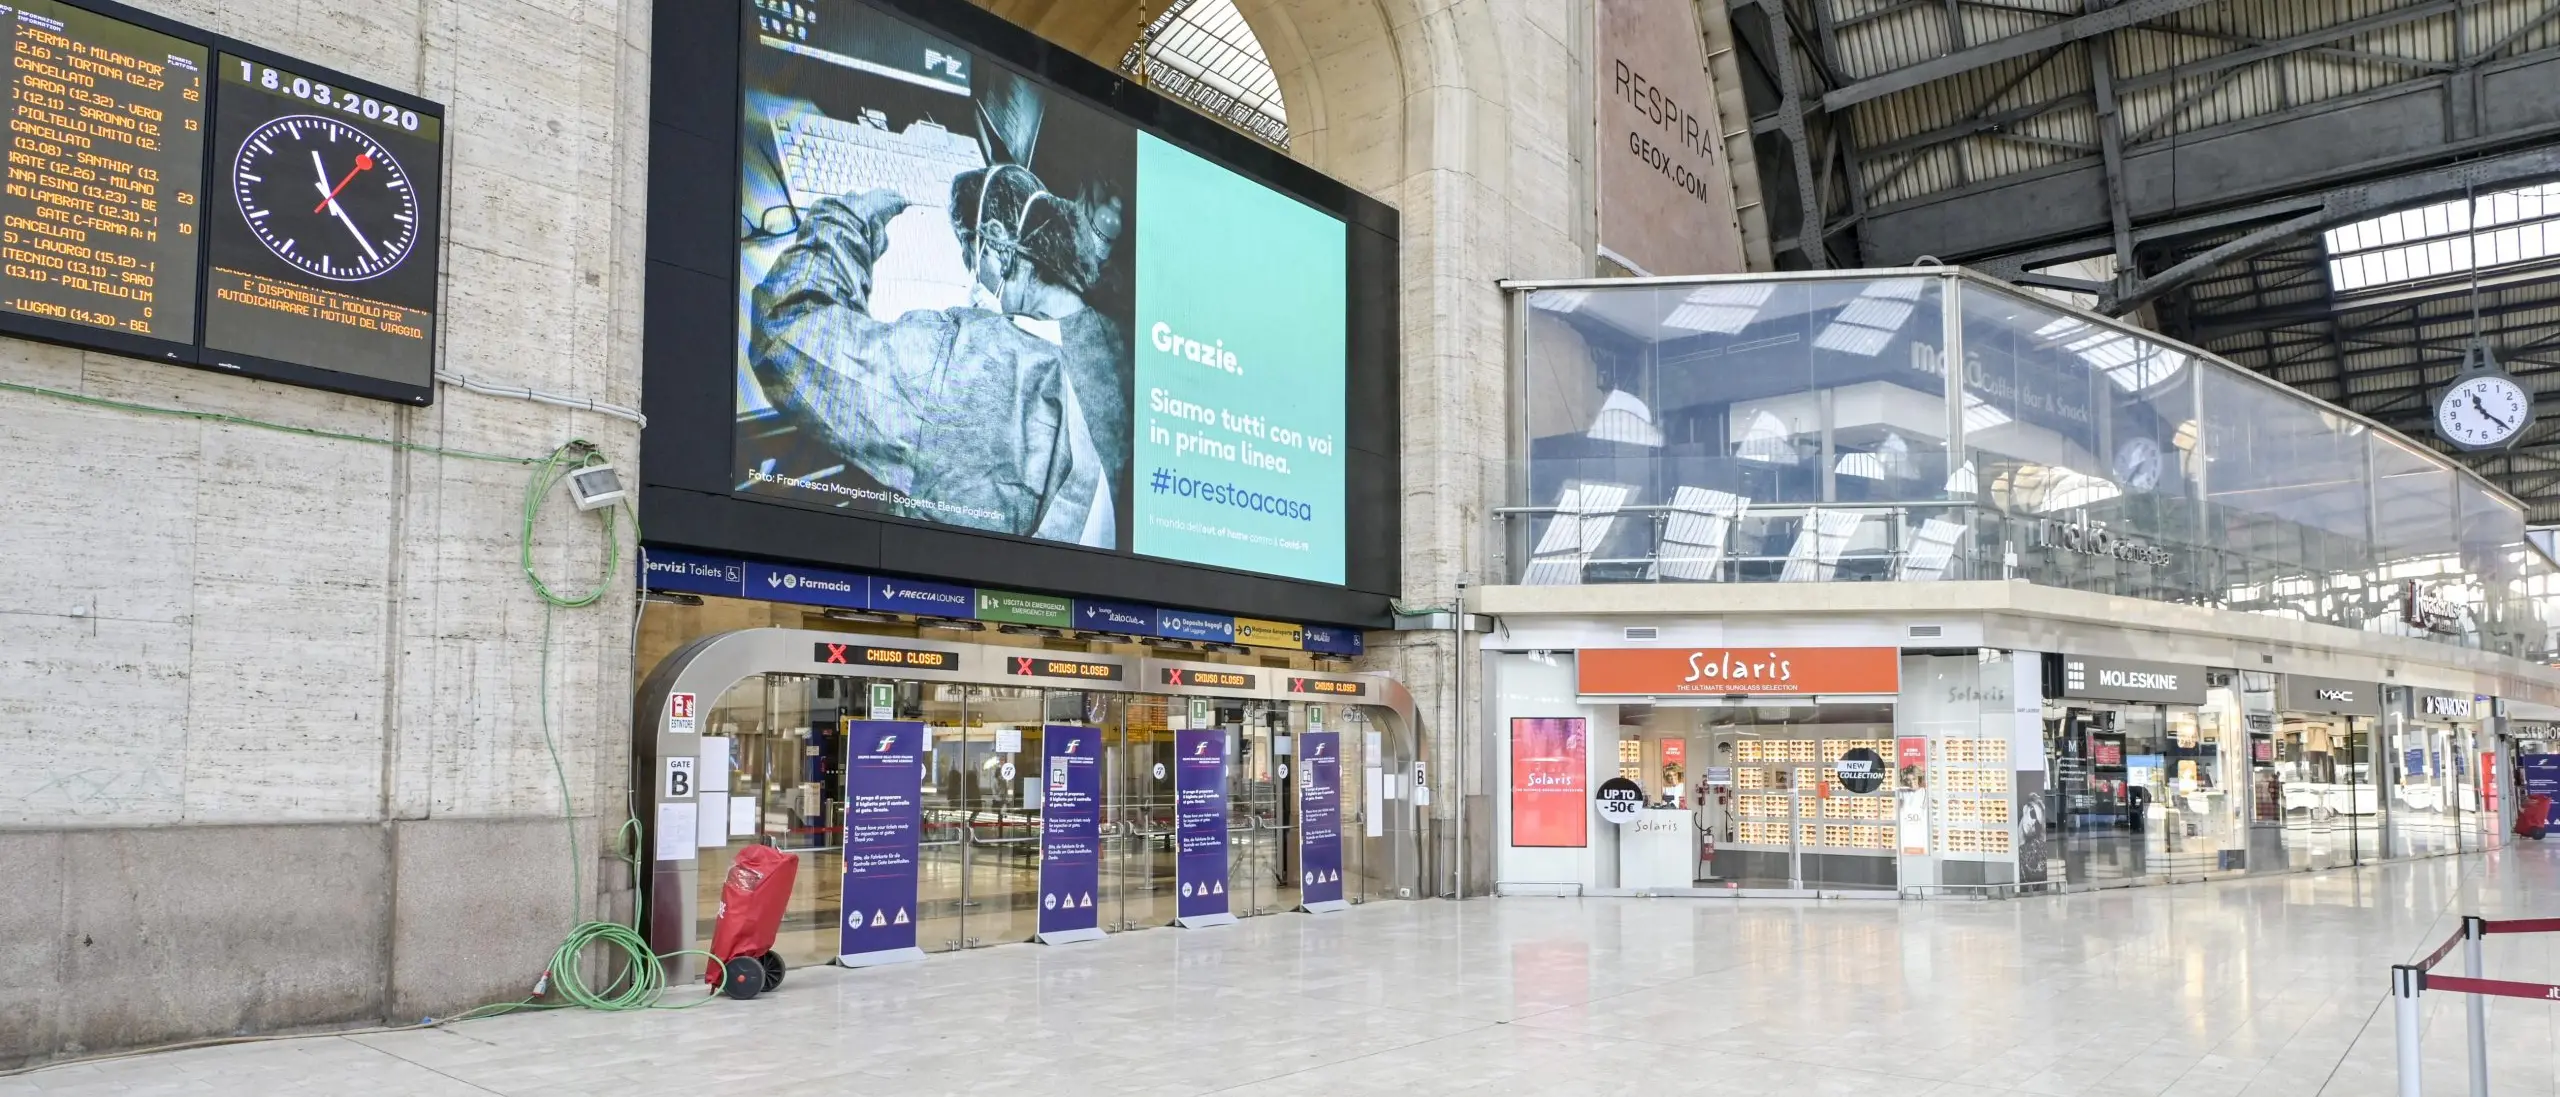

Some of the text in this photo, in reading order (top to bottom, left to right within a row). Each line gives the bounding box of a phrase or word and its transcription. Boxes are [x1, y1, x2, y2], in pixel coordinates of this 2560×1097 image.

[17, 15, 61, 32] INFORMATION
[18, 10, 64, 28] INFORMAZIONI
[68, 55, 123, 80] TORTONA
[73, 42, 165, 76] A: MILANO POR
[167, 60, 198, 72] PLATFORM
[14, 57, 94, 87] CANCELLATO
[194, 77, 199, 87] 1
[23, 75, 66, 95] GARDA
[70, 87, 114, 108] (12.32)
[183, 88, 199, 101] 22
[240, 60, 419, 131] 18.03.2020
[24, 91, 64, 110] (12.11)
[79, 106, 135, 129] SARONNO
[1616, 58, 1715, 166] RESPIRA
[18, 106, 132, 144] PIOLTELLO LIMITO
[184, 119, 198, 131] 13
[11, 120, 91, 148] CANCELLATO
[15, 137, 62, 157] (13.08)
[77, 152, 134, 175] SANTHIA'
[1629, 131, 1707, 204] GEOX.COM
[50, 162, 154, 195] (12.26) MILANO
[40, 176, 157, 212] ESINO (13.23) BE
[177, 192, 194, 205] 23
[31, 188, 140, 221] LAMBRATE (12.31)
[5, 215, 85, 241] CANCELLATO
[37, 206, 156, 242] GATE C-FERMA A: M
[179, 223, 192, 234] 10
[4, 232, 136, 268] 5) LAVORGO (15.12)
[67, 260, 107, 278] (13.11)
[6, 264, 153, 302] (13.11) PIOLTELLO LIM
[244, 280, 402, 321] E' DISPONIBILE IL MODULO PER
[17, 298, 151, 333] LUGANO (14.30) BEL
[144, 307, 152, 318] G
[217, 288, 424, 339] AUTODICHIARARE I MOTIVI DEL VIAGGIO.
[1151, 320, 1244, 376] Grazie.
[2464, 389, 2470, 398] 11
[2477, 384, 2487, 392] 12
[2496, 385, 2500, 393] 1
[2507, 392, 2512, 401] 2
[2023, 387, 2043, 408] Bar
[2452, 399, 2462, 408] 10
[2450, 412, 2456, 420] 9
[2511, 403, 2518, 412] 3
[1150, 387, 1333, 456] Siamo tutti con voi
[2455, 423, 2461, 431] 8
[2508, 416, 2514, 424] 4
[2466, 430, 2473, 438] 7
[2481, 431, 2488, 439] 6
[2497, 426, 2503, 434] 5
[1150, 418, 1292, 475] in prima linea.
[748, 468, 776, 483] Foto:
[776, 474, 829, 492] Francesca
[830, 482, 887, 502] Mangiatordi
[892, 494, 936, 511] Soggetto:
[937, 501, 962, 515] Elena
[1150, 466, 1312, 522] #iorestoacasa
[1156, 517, 1185, 530] mondo
[1217, 527, 1226, 537] of
[689, 563, 722, 578] Toilets
[799, 576, 851, 593] Farmacia
[1003, 598, 1024, 607] USCITA
[1032, 602, 1065, 611] EMERGENZA
[1012, 607, 1044, 616] EMERGENCY
[1182, 618, 1223, 630] Deposito Bagagli
[867, 649, 943, 666] CHIUSO CLOSED
[1048, 662, 1109, 676] CHIUSO CLOSED
[1685, 651, 1792, 682] Solaris
[1194, 673, 1244, 686] CHIUSO CLOSED
[1315, 681, 1356, 693] CHIUSO CLOSED
[2100, 669, 2178, 690] MOLESKINE
[1948, 686, 2005, 703] Solaris
[2319, 689, 2353, 702] MAC
[2434, 697, 2471, 716] SWAROVSKI
[671, 760, 690, 768] GATE
[1846, 762, 1865, 770] NEW
[671, 771, 689, 796] B
[1418, 770, 1424, 784] B
[1528, 773, 1572, 786] Solaris
[1839, 771, 1885, 780] COLLECTION
[1604, 789, 1635, 800] UP TO
[1604, 801, 1635, 813] -50€
[1635, 819, 1679, 832] Solaris
